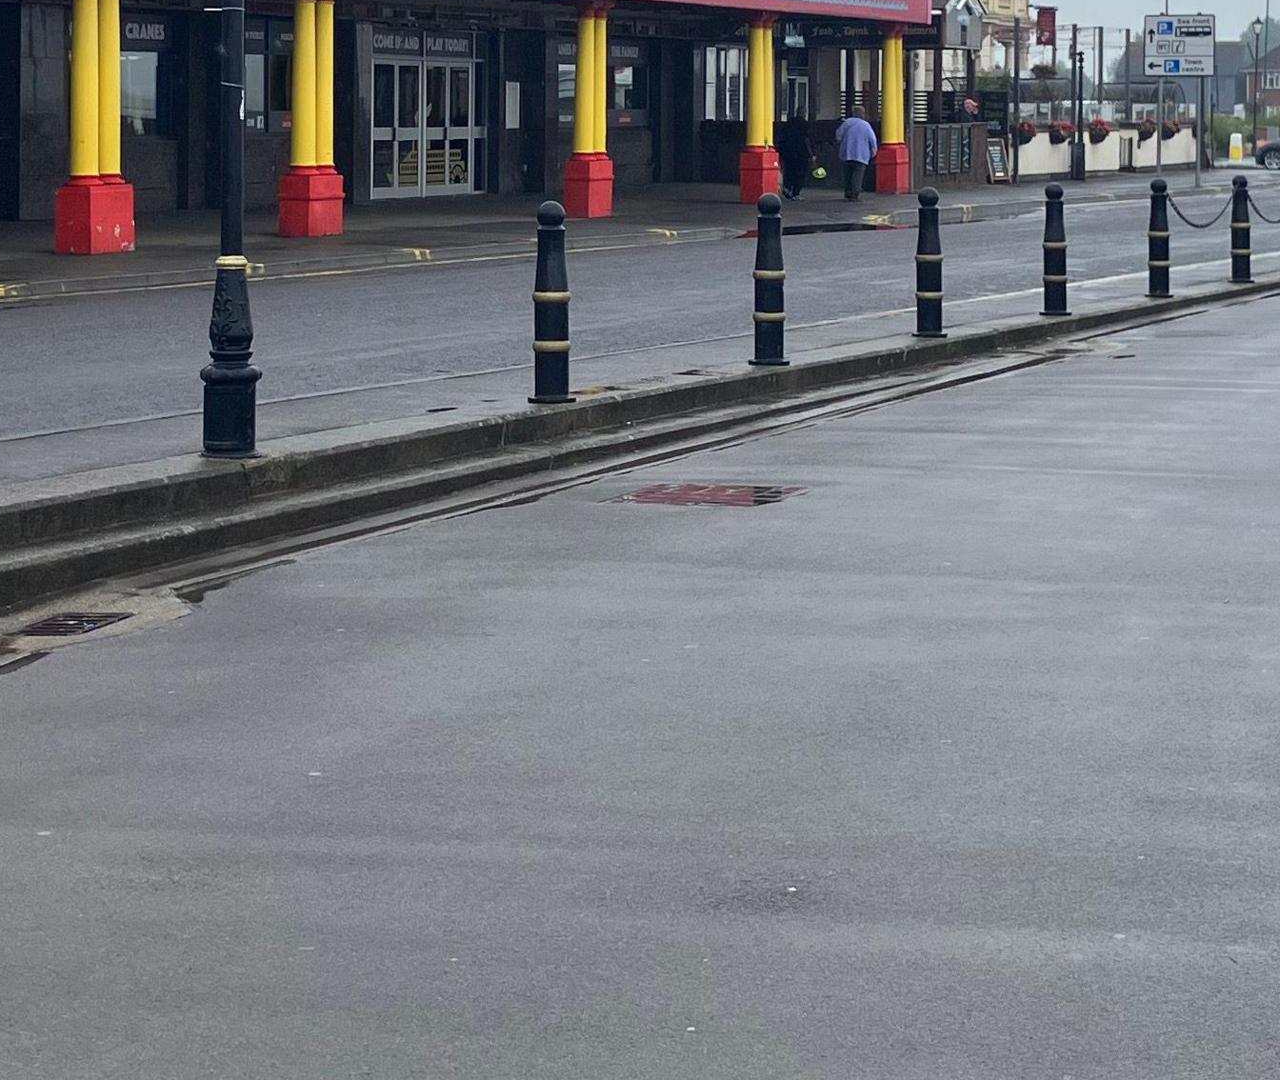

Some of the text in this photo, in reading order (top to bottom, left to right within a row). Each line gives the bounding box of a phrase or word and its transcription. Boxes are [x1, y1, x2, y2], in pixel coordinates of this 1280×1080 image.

[125, 22, 165, 41] CRANES
[373, 33, 394, 48] COME
[404, 36, 419, 51] AND
[426, 38, 445, 52] PLAY
